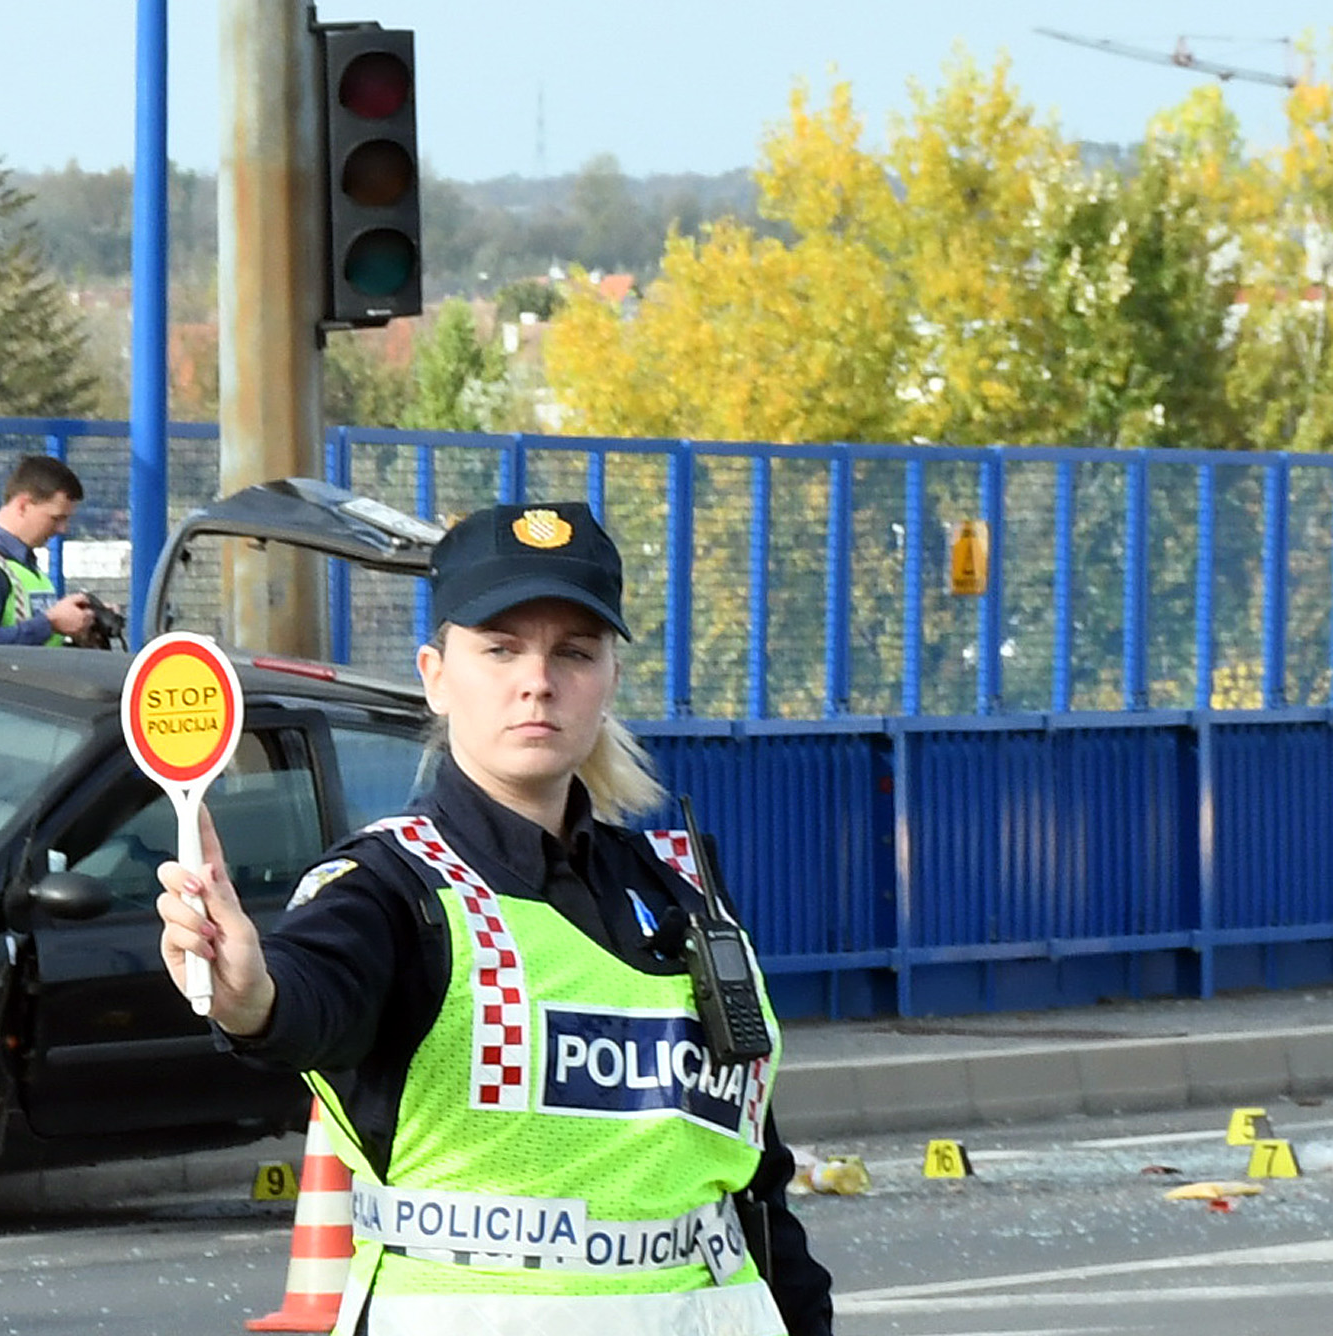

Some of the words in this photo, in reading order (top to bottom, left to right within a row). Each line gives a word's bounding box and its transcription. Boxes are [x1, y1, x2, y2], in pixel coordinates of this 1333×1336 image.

[146, 686, 218, 709] STOP
[147, 717, 219, 735] POLICIJA
[555, 1033, 745, 1107] POLICIJA
[934, 1144, 954, 1172] 16
[1262, 1144, 1278, 1177] 7
[267, 1166, 285, 1196] 9
[396, 1199, 578, 1246] POLICIJA
[585, 1217, 705, 1266] OLICIJA
